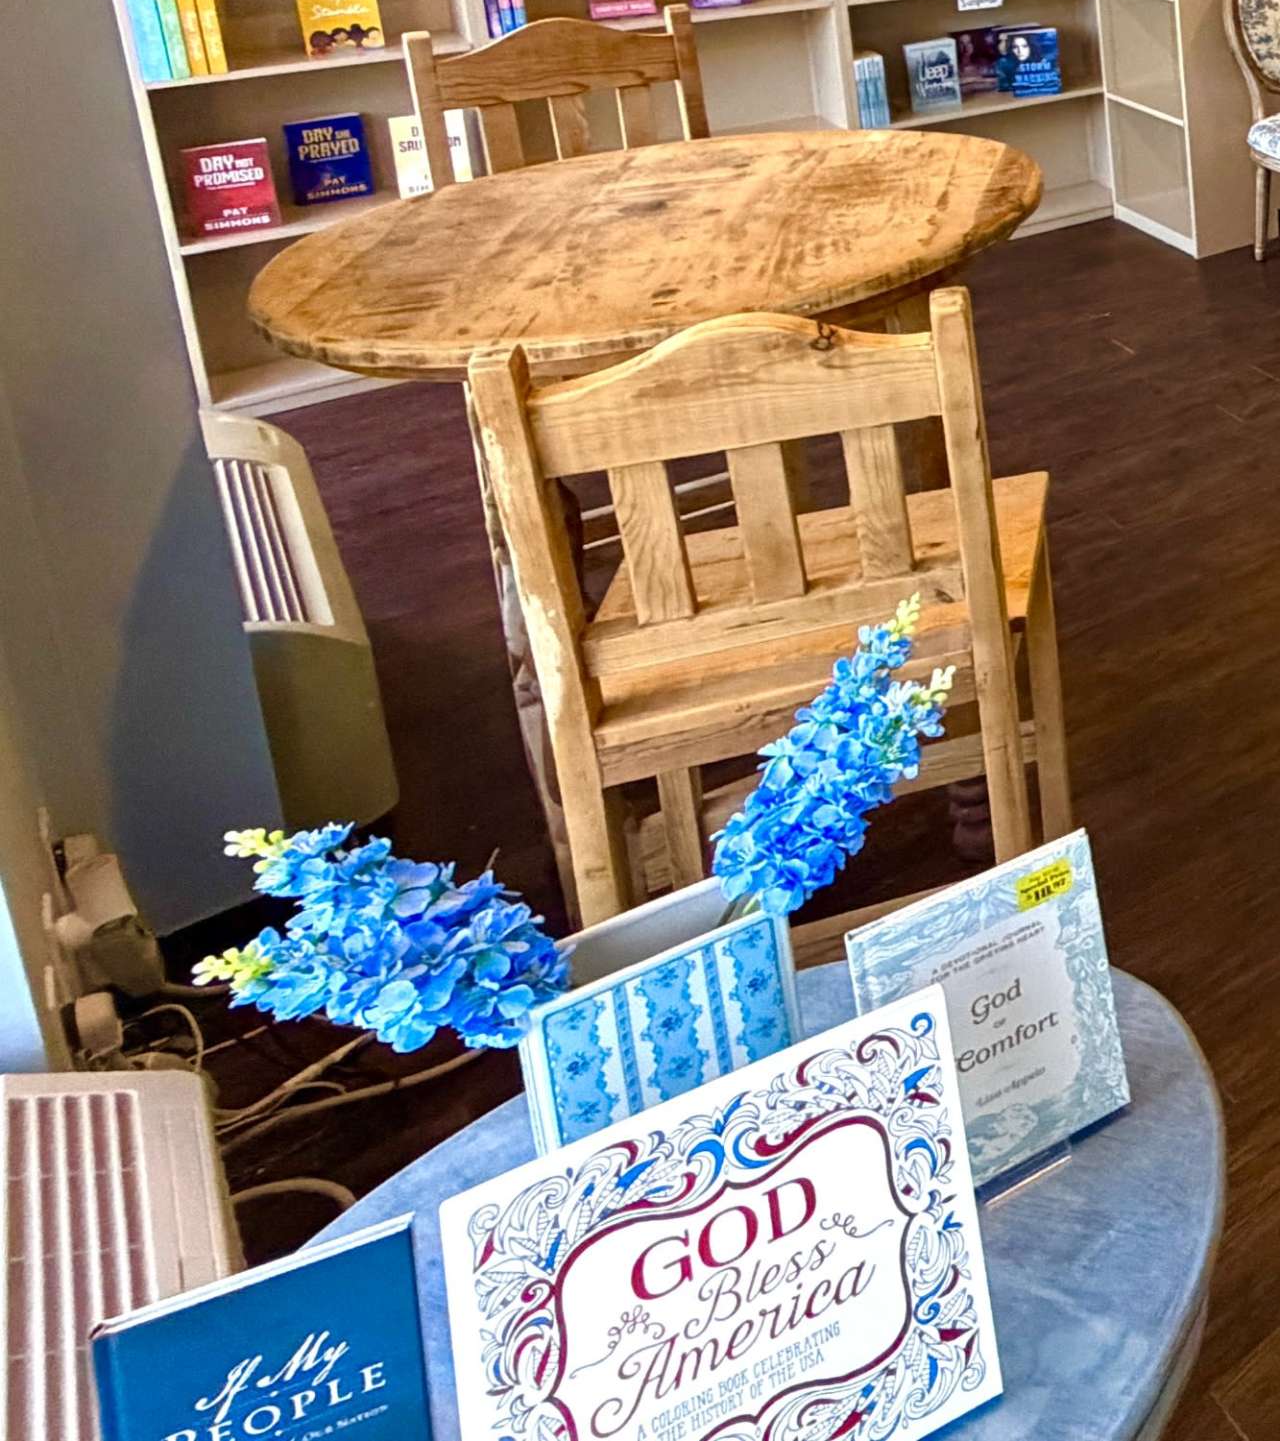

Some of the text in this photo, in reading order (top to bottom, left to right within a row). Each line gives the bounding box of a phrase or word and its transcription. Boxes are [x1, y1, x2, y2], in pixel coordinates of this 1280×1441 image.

[298, 137, 361, 161] PRAYED
[310, 127, 333, 143] DAY
[193, 166, 265, 188] PROMISED
[200, 154, 235, 174] DAY
[307, 184, 367, 201] SIMMONS
[204, 215, 271, 232] SIMMONS
[953, 960, 971, 974] THE
[1017, 926, 1045, 944] HEART
[970, 977, 1022, 1025] God
[956, 1011, 1060, 1073] Comfort
[630, 1176, 818, 1301] GOD
[683, 1238, 837, 1340] Bless
[590, 1259, 877, 1439] America
[195, 1330, 350, 1424] If My
[637, 1320, 841, 1441] A COLORING BOOK CELEBRATING
[690, 1388, 745, 1432] HISTORY
[749, 1380, 765, 1400] OF
[767, 1363, 796, 1390] THE
[800, 1348, 826, 1373] USA
